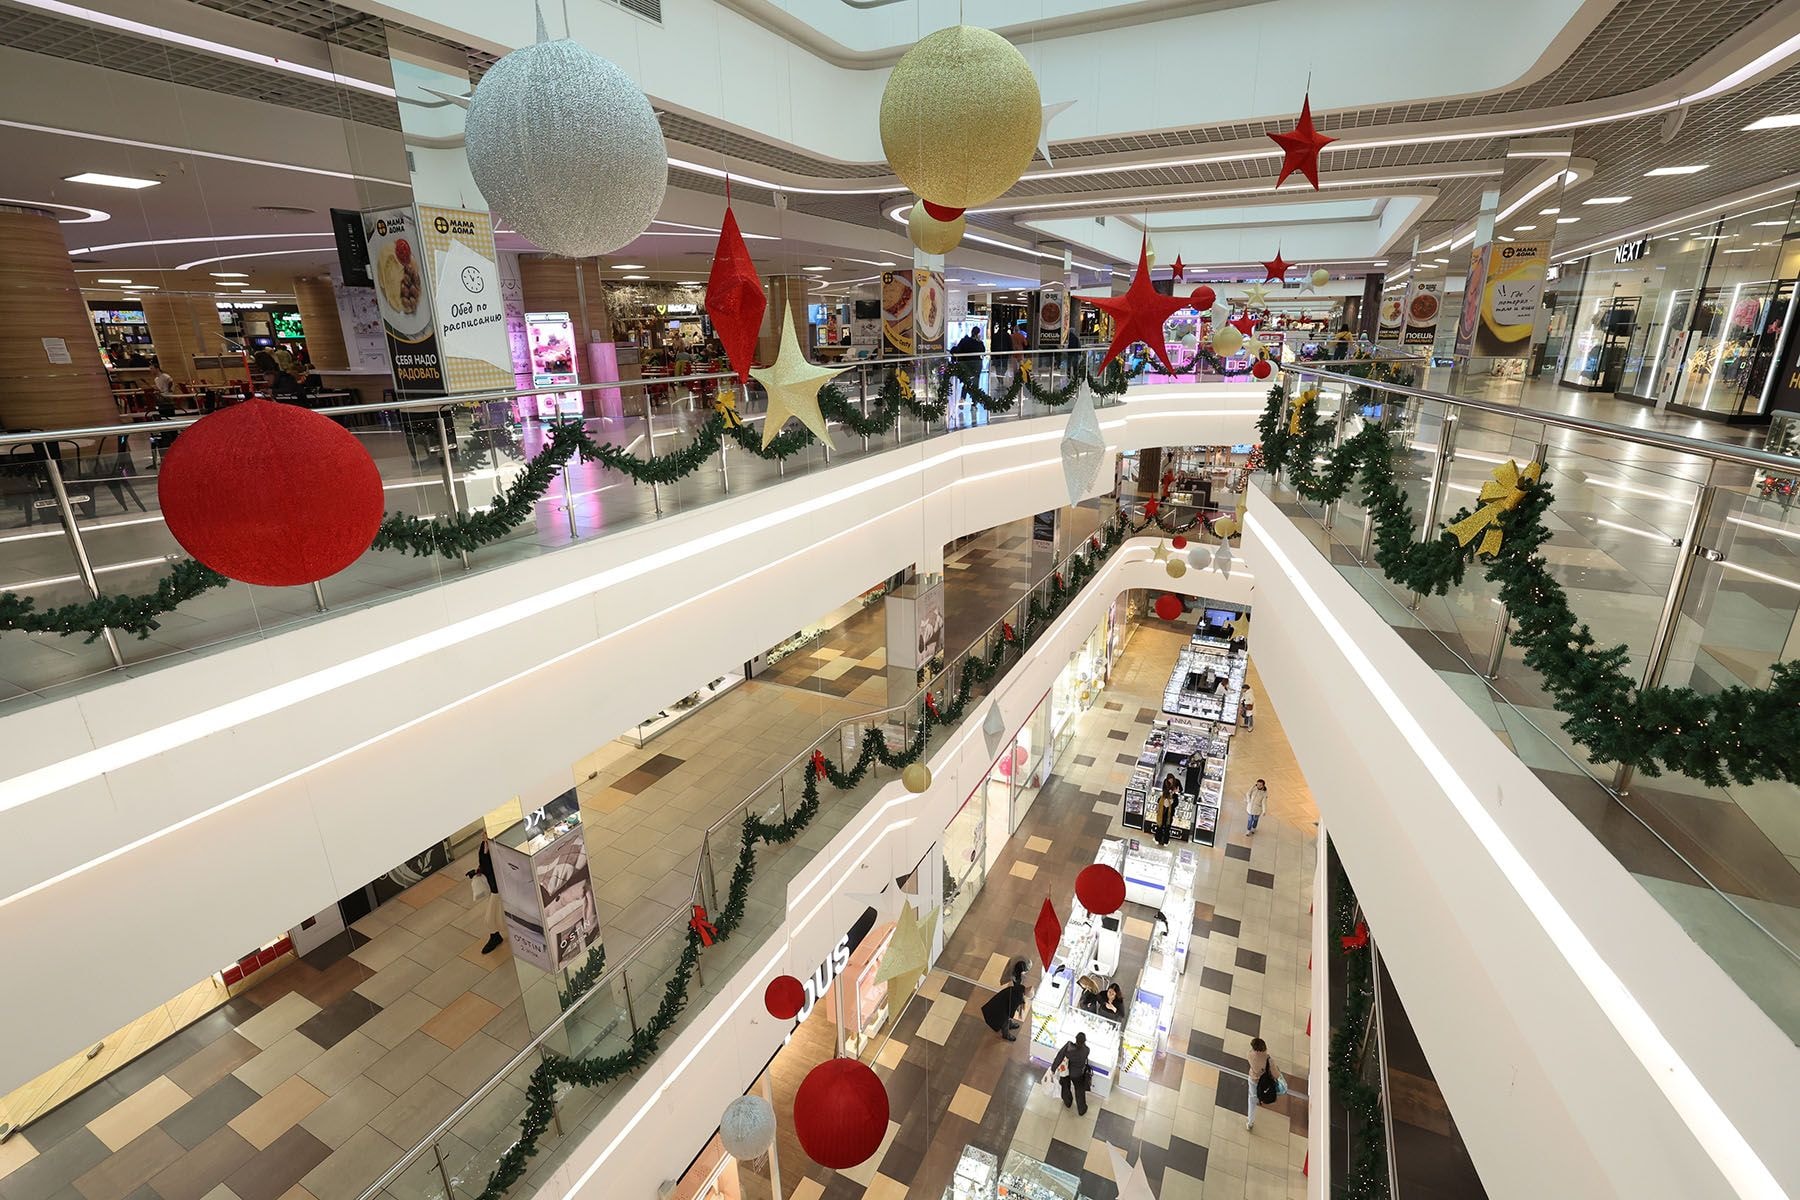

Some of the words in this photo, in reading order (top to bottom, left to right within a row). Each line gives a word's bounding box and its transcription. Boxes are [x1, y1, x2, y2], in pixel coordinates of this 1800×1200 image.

[386, 218, 405, 227] МАМА
[388, 225, 406, 234] ДОМА
[449, 219, 475, 229] МАМА
[451, 227, 475, 236] ДОМА
[1613, 240, 1643, 265] NEXT
[451, 301, 473, 318] Обед
[476, 302, 488, 315] по
[443, 312, 503, 336] расписанию
[1405, 331, 1434, 339] ПОЕШЬ
[395, 353, 413, 366] СЕБЯ
[414, 353, 437, 367] НАДО
[398, 367, 440, 381] РАДОВАТЬ
[513, 933, 543, 953] O'STIN
